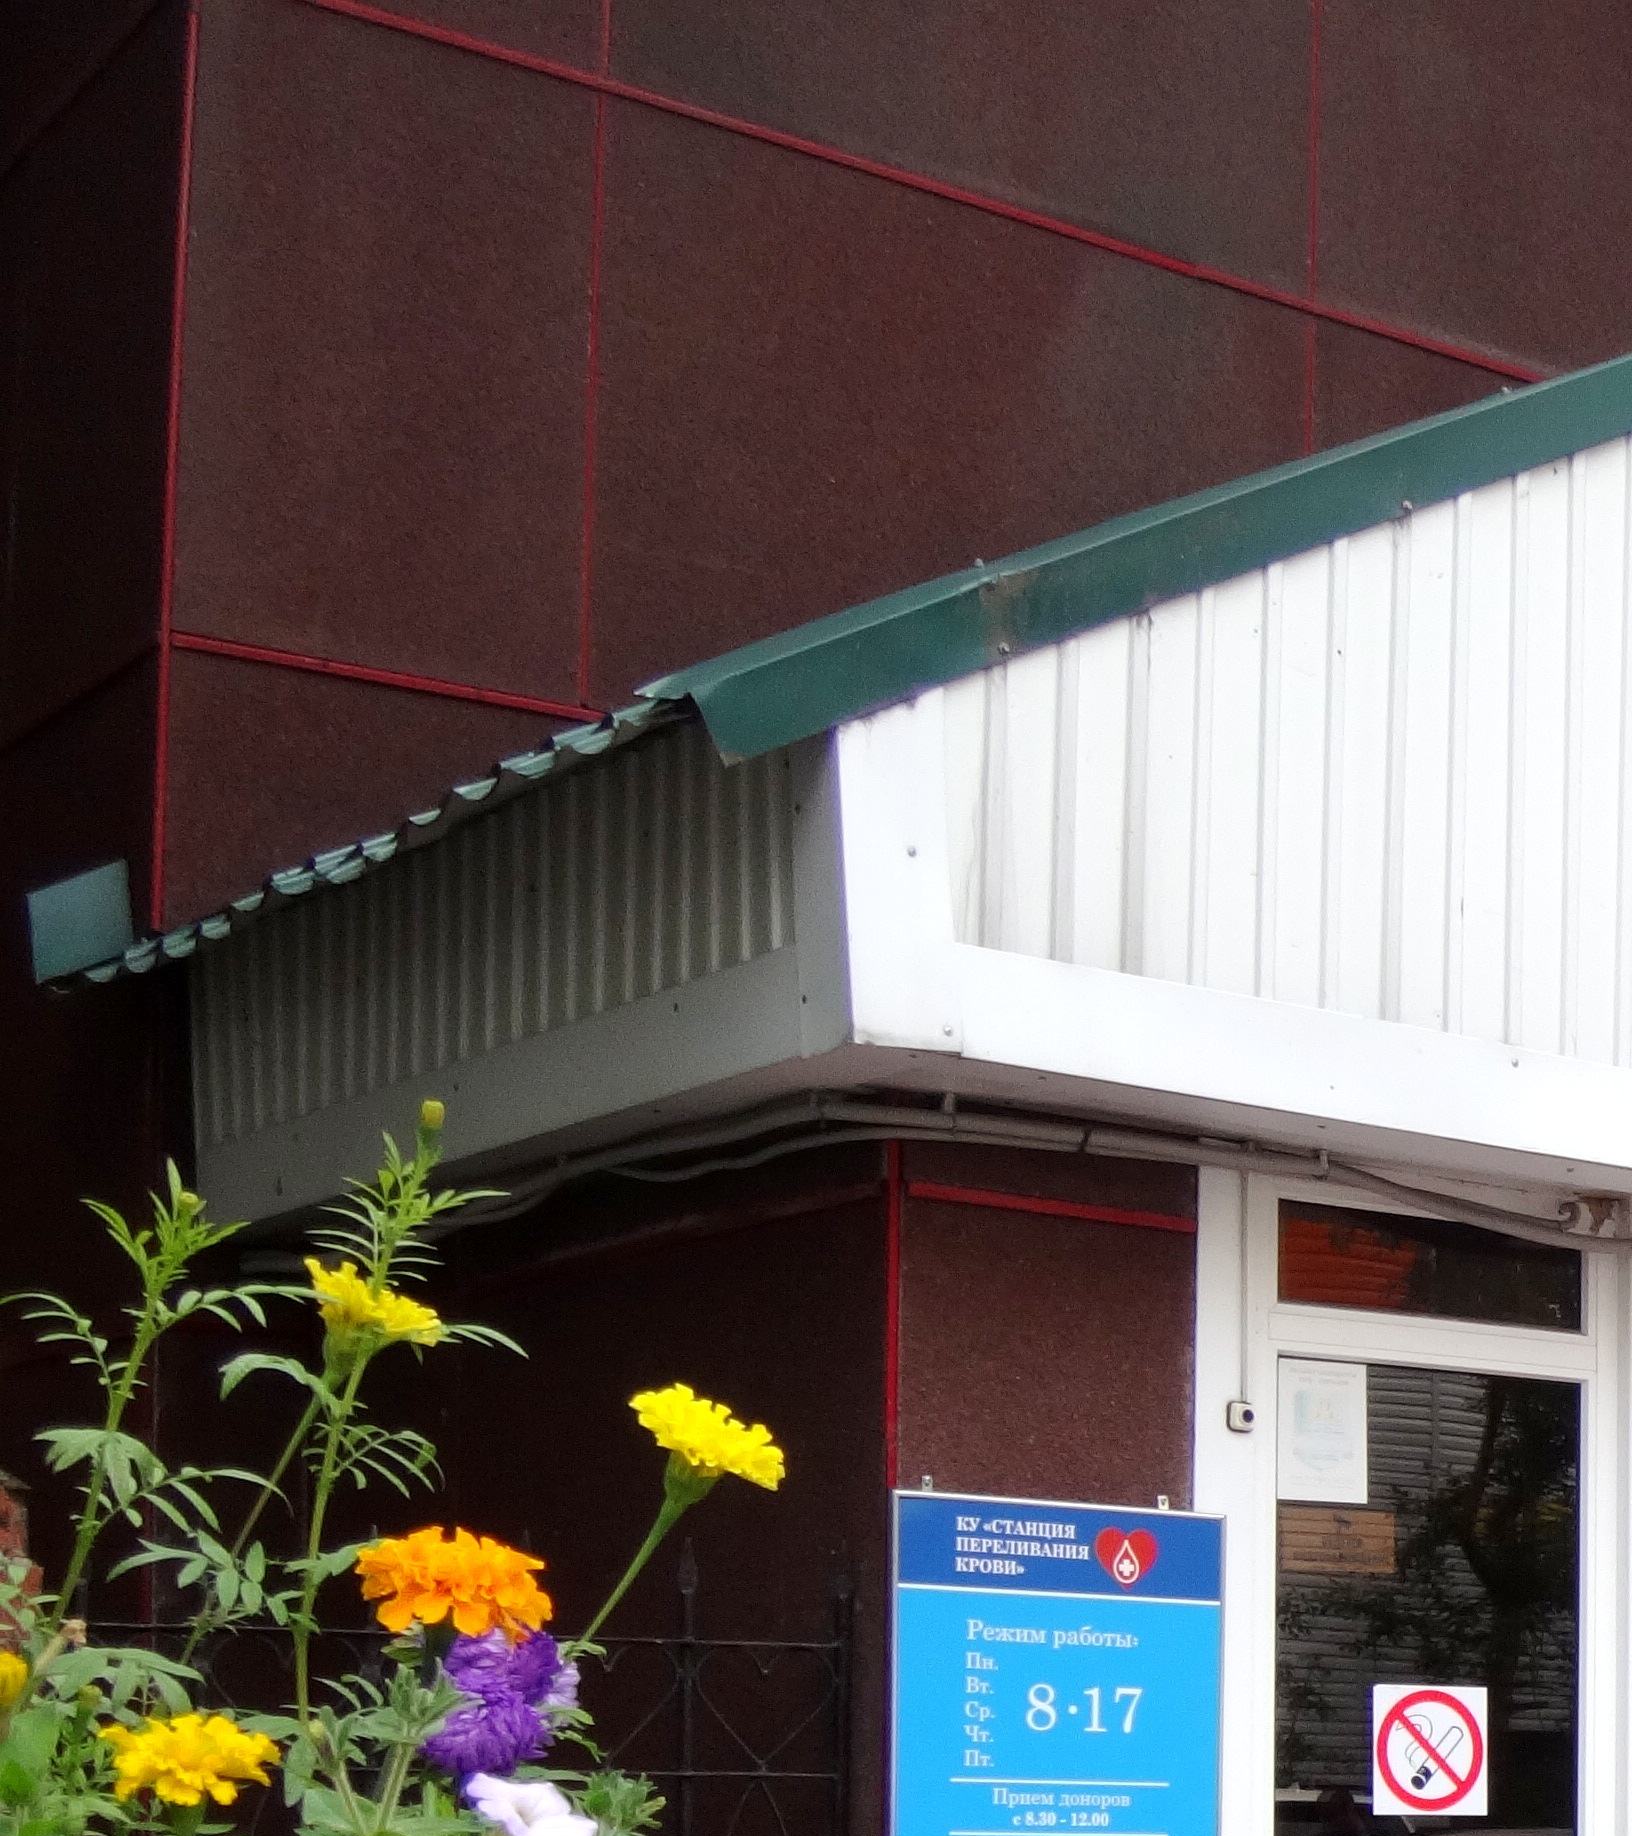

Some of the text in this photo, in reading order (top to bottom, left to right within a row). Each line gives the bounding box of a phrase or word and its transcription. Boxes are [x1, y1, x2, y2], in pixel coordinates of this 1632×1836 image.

[956, 1516, 1076, 1540] КУ «СТАНЦИЯ
[956, 1537, 1089, 1560] ПЕРЕЛИВАНИЯ
[955, 1557, 1025, 1575] КРОВИ»
[966, 1619, 1139, 1650] Режим работы:
[966, 1652, 999, 1670] Пн.
[966, 1676, 994, 1694] Вт.
[965, 1701, 996, 1721] Ср.
[964, 1725, 994, 1742] Чт.
[964, 1750, 994, 1767] Пт.
[993, 1788, 1131, 1810] Прием доноров
[1012, 1815, 1021, 1826] с
[1025, 1812, 1056, 1826] 8.30
[1071, 1812, 1110, 1827] 12.00
